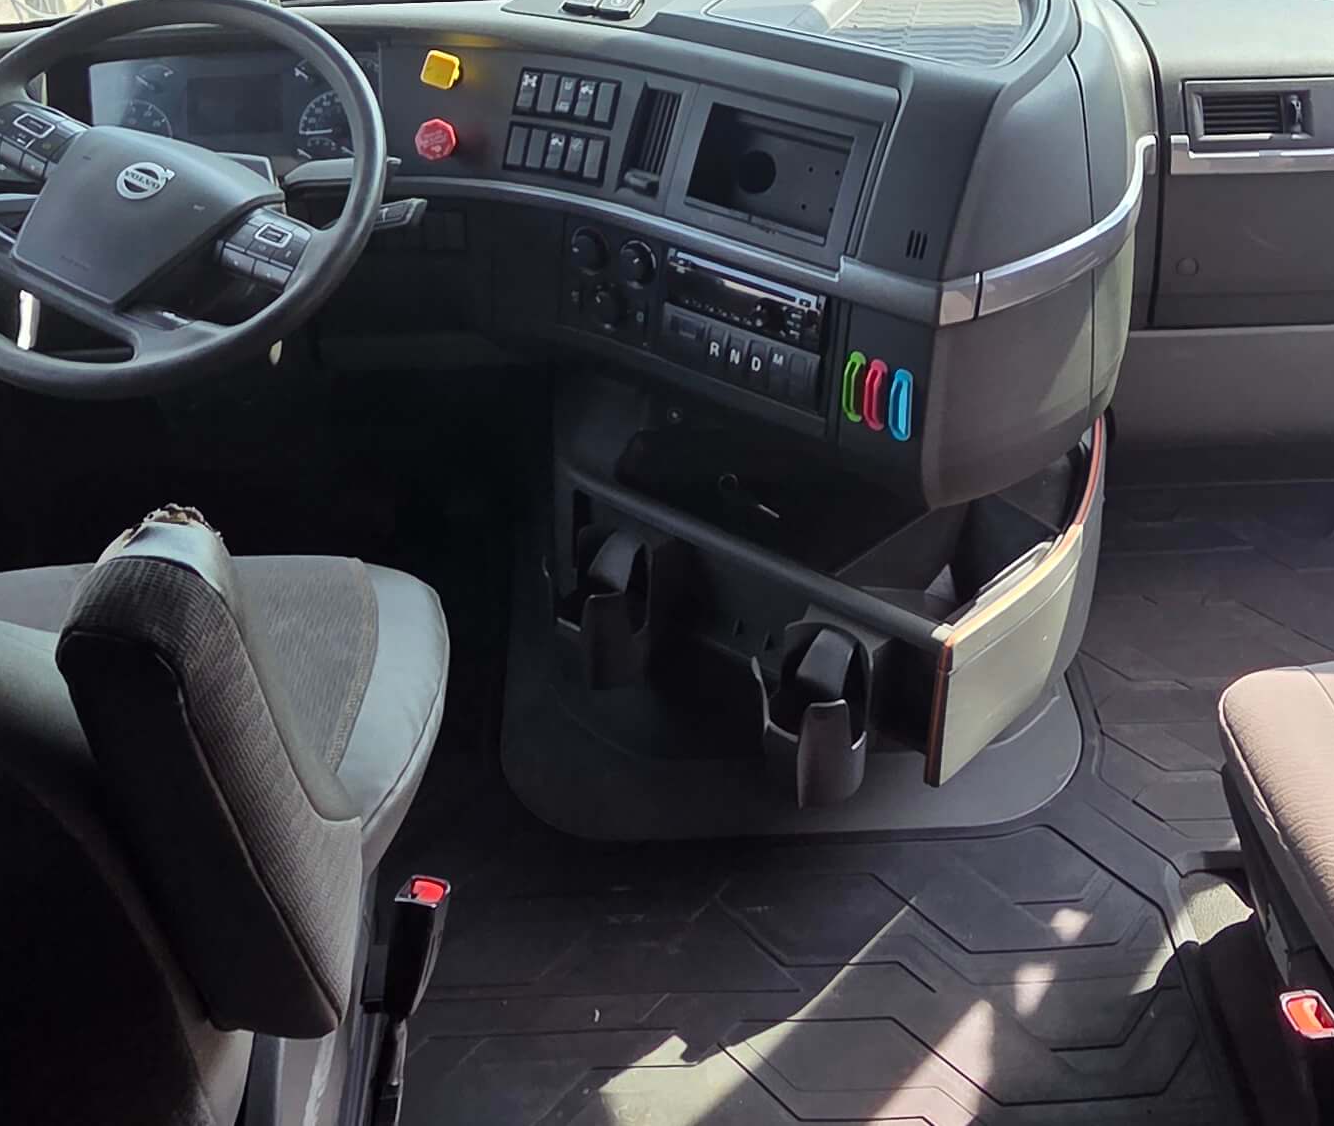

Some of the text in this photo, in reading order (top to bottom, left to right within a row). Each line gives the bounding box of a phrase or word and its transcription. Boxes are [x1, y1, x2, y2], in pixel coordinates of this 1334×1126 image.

[709, 341, 720, 358] R
[729, 348, 740, 365] N
[751, 355, 762, 372] D
